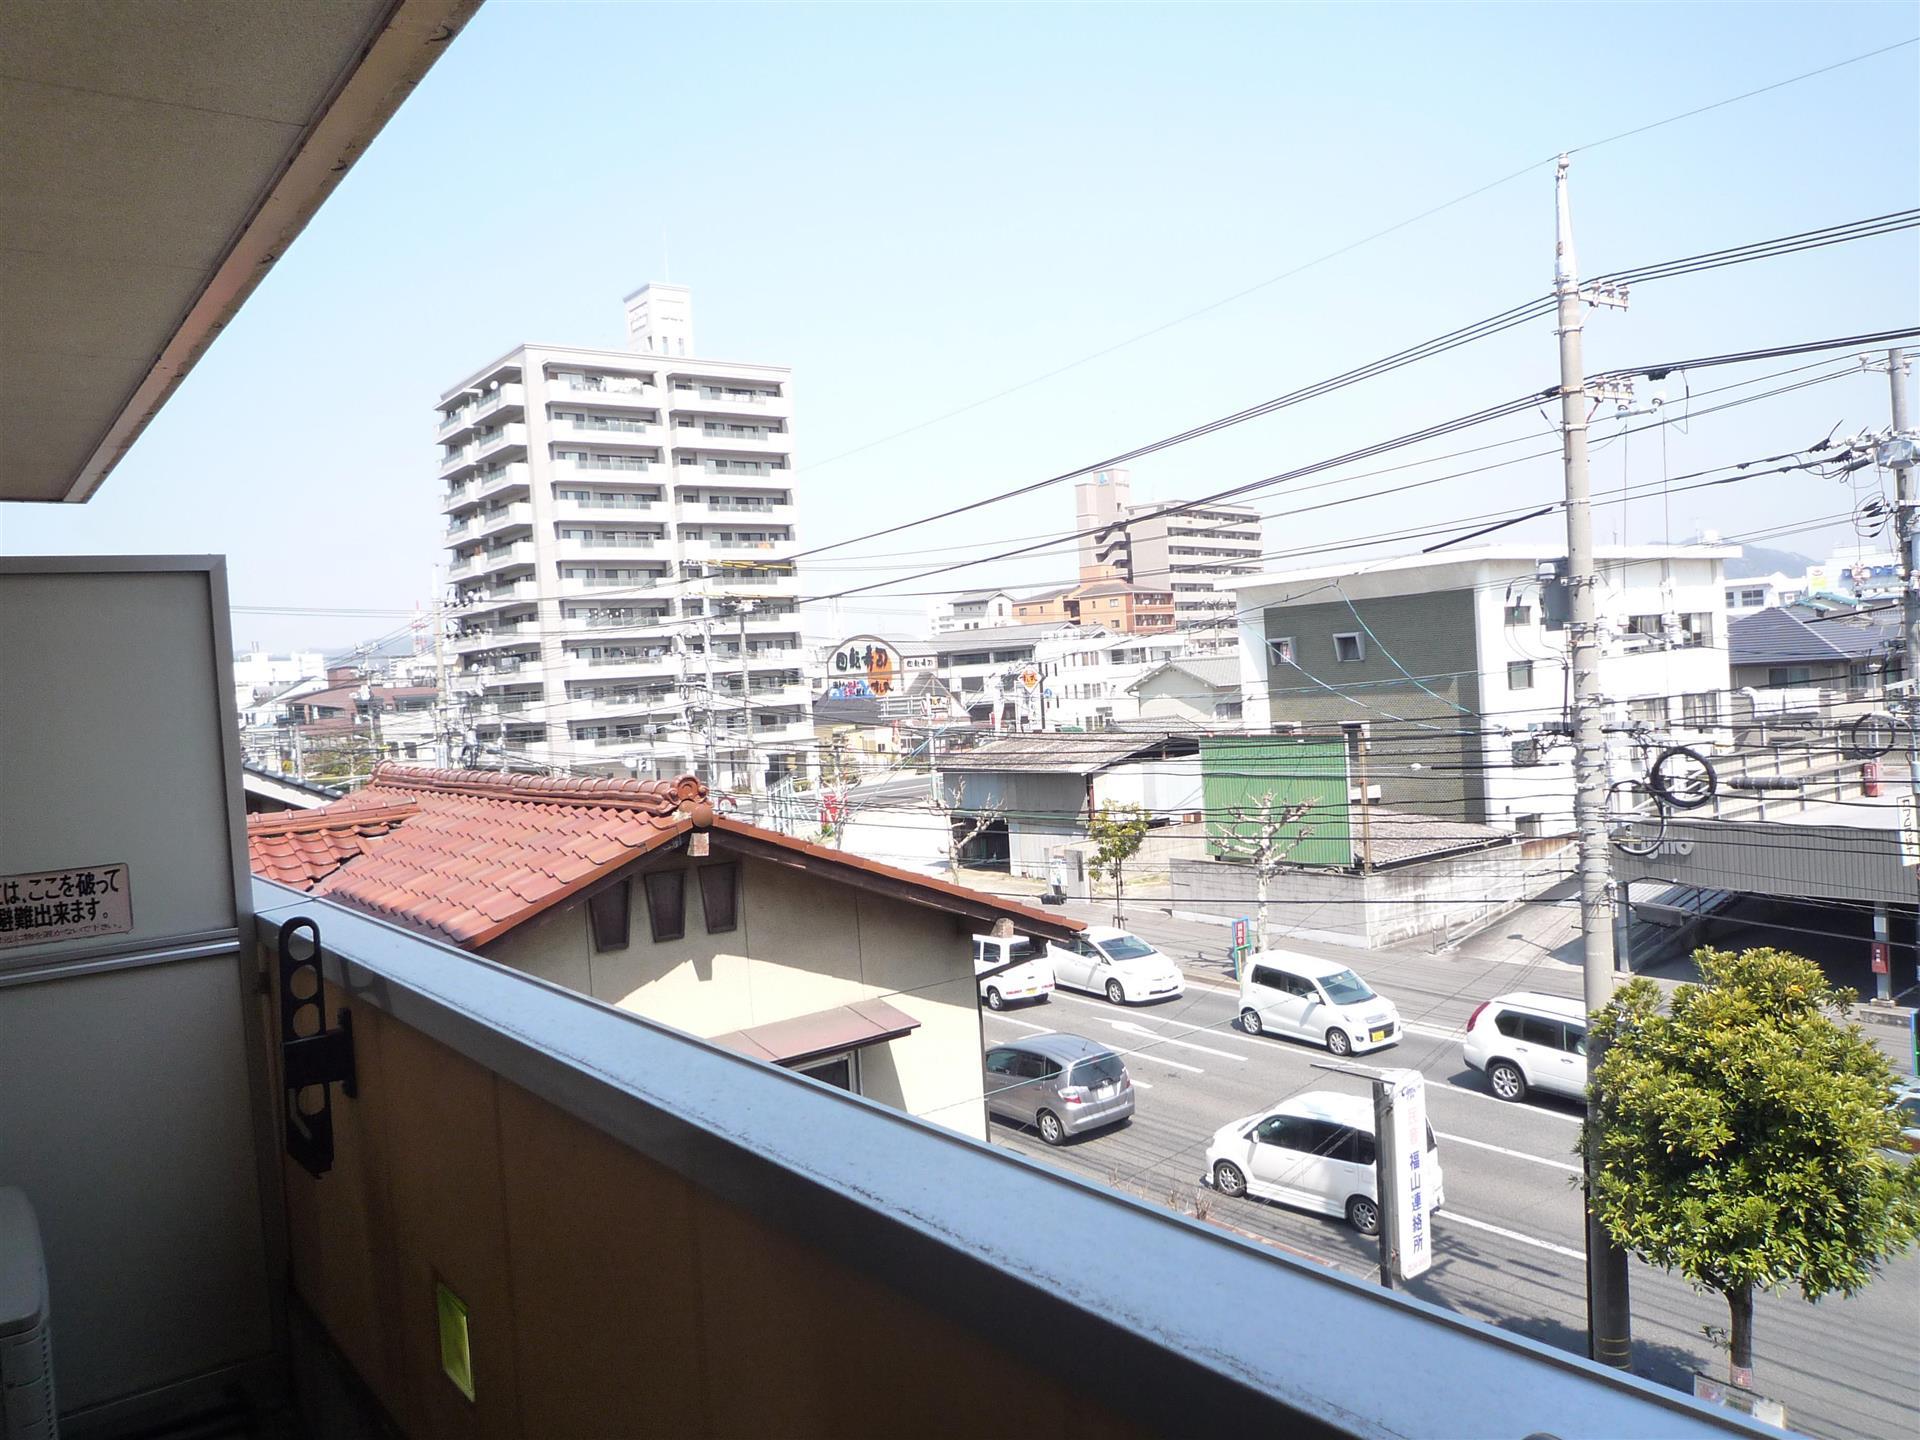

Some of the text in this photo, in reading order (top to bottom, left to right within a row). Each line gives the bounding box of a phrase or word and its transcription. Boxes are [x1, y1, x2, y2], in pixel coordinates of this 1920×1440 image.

[0, 868, 121, 905] は、ここを破って
[1408, 1150, 1424, 1254] 福山連絡所
